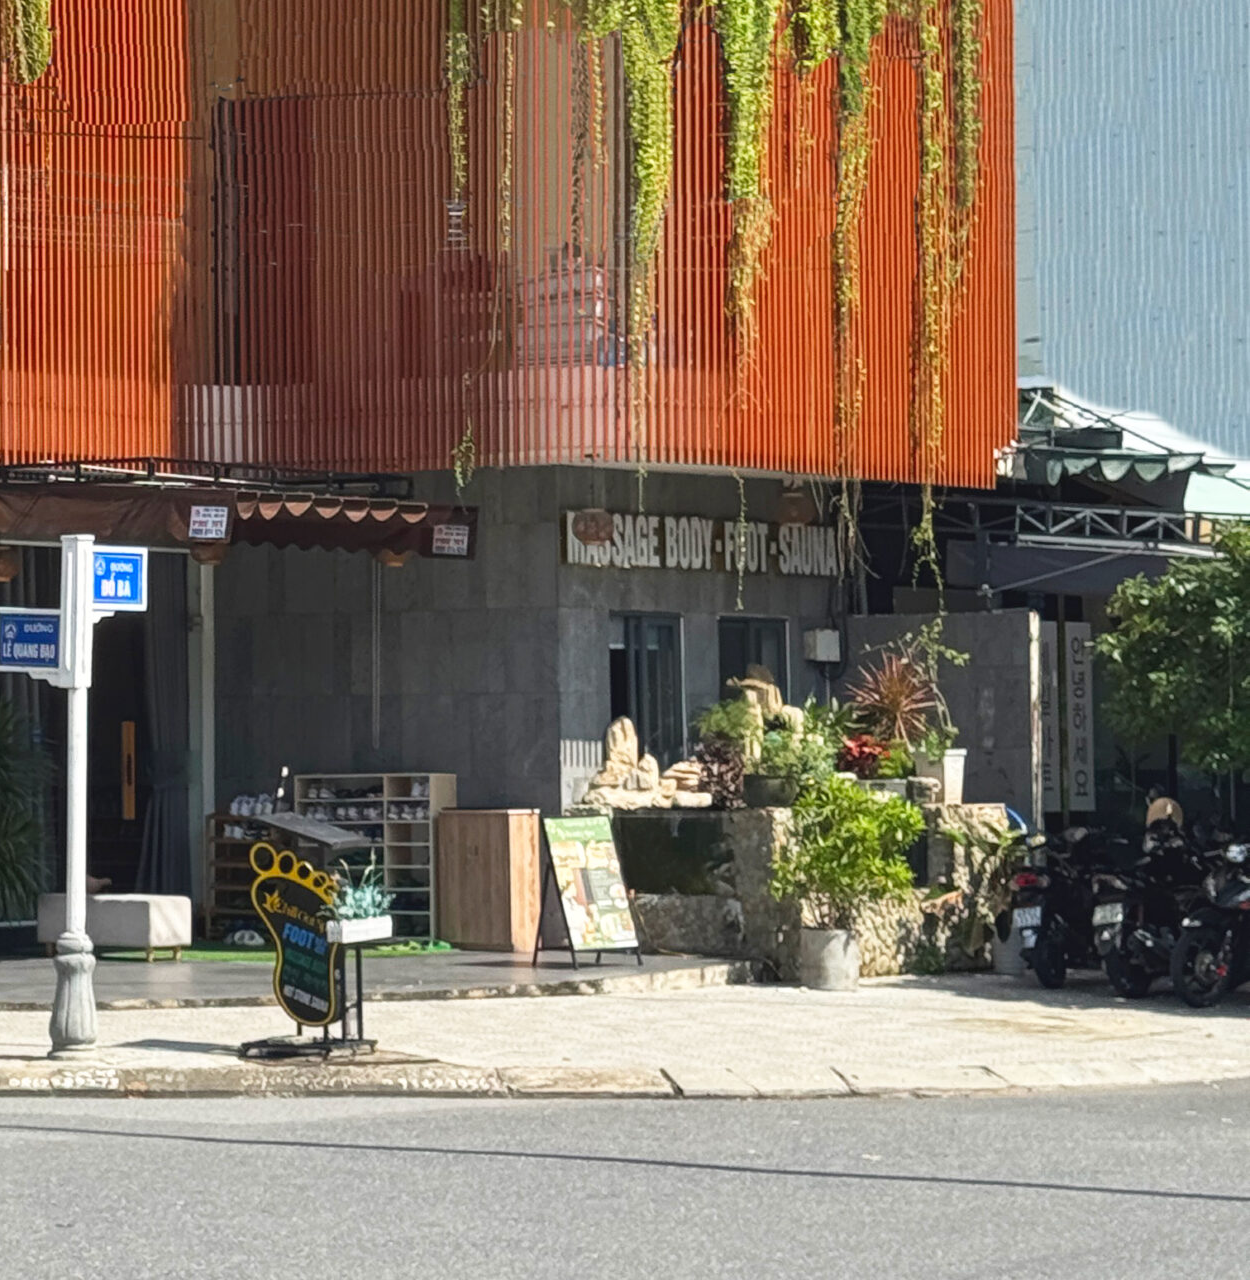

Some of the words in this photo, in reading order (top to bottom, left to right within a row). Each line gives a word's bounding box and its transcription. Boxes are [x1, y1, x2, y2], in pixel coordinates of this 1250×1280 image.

[665, 516, 713, 570] BODY
[778, 524, 838, 577] SAUNA
[13, 643, 38, 660] QUANG
[282, 922, 316, 949] FOOT
